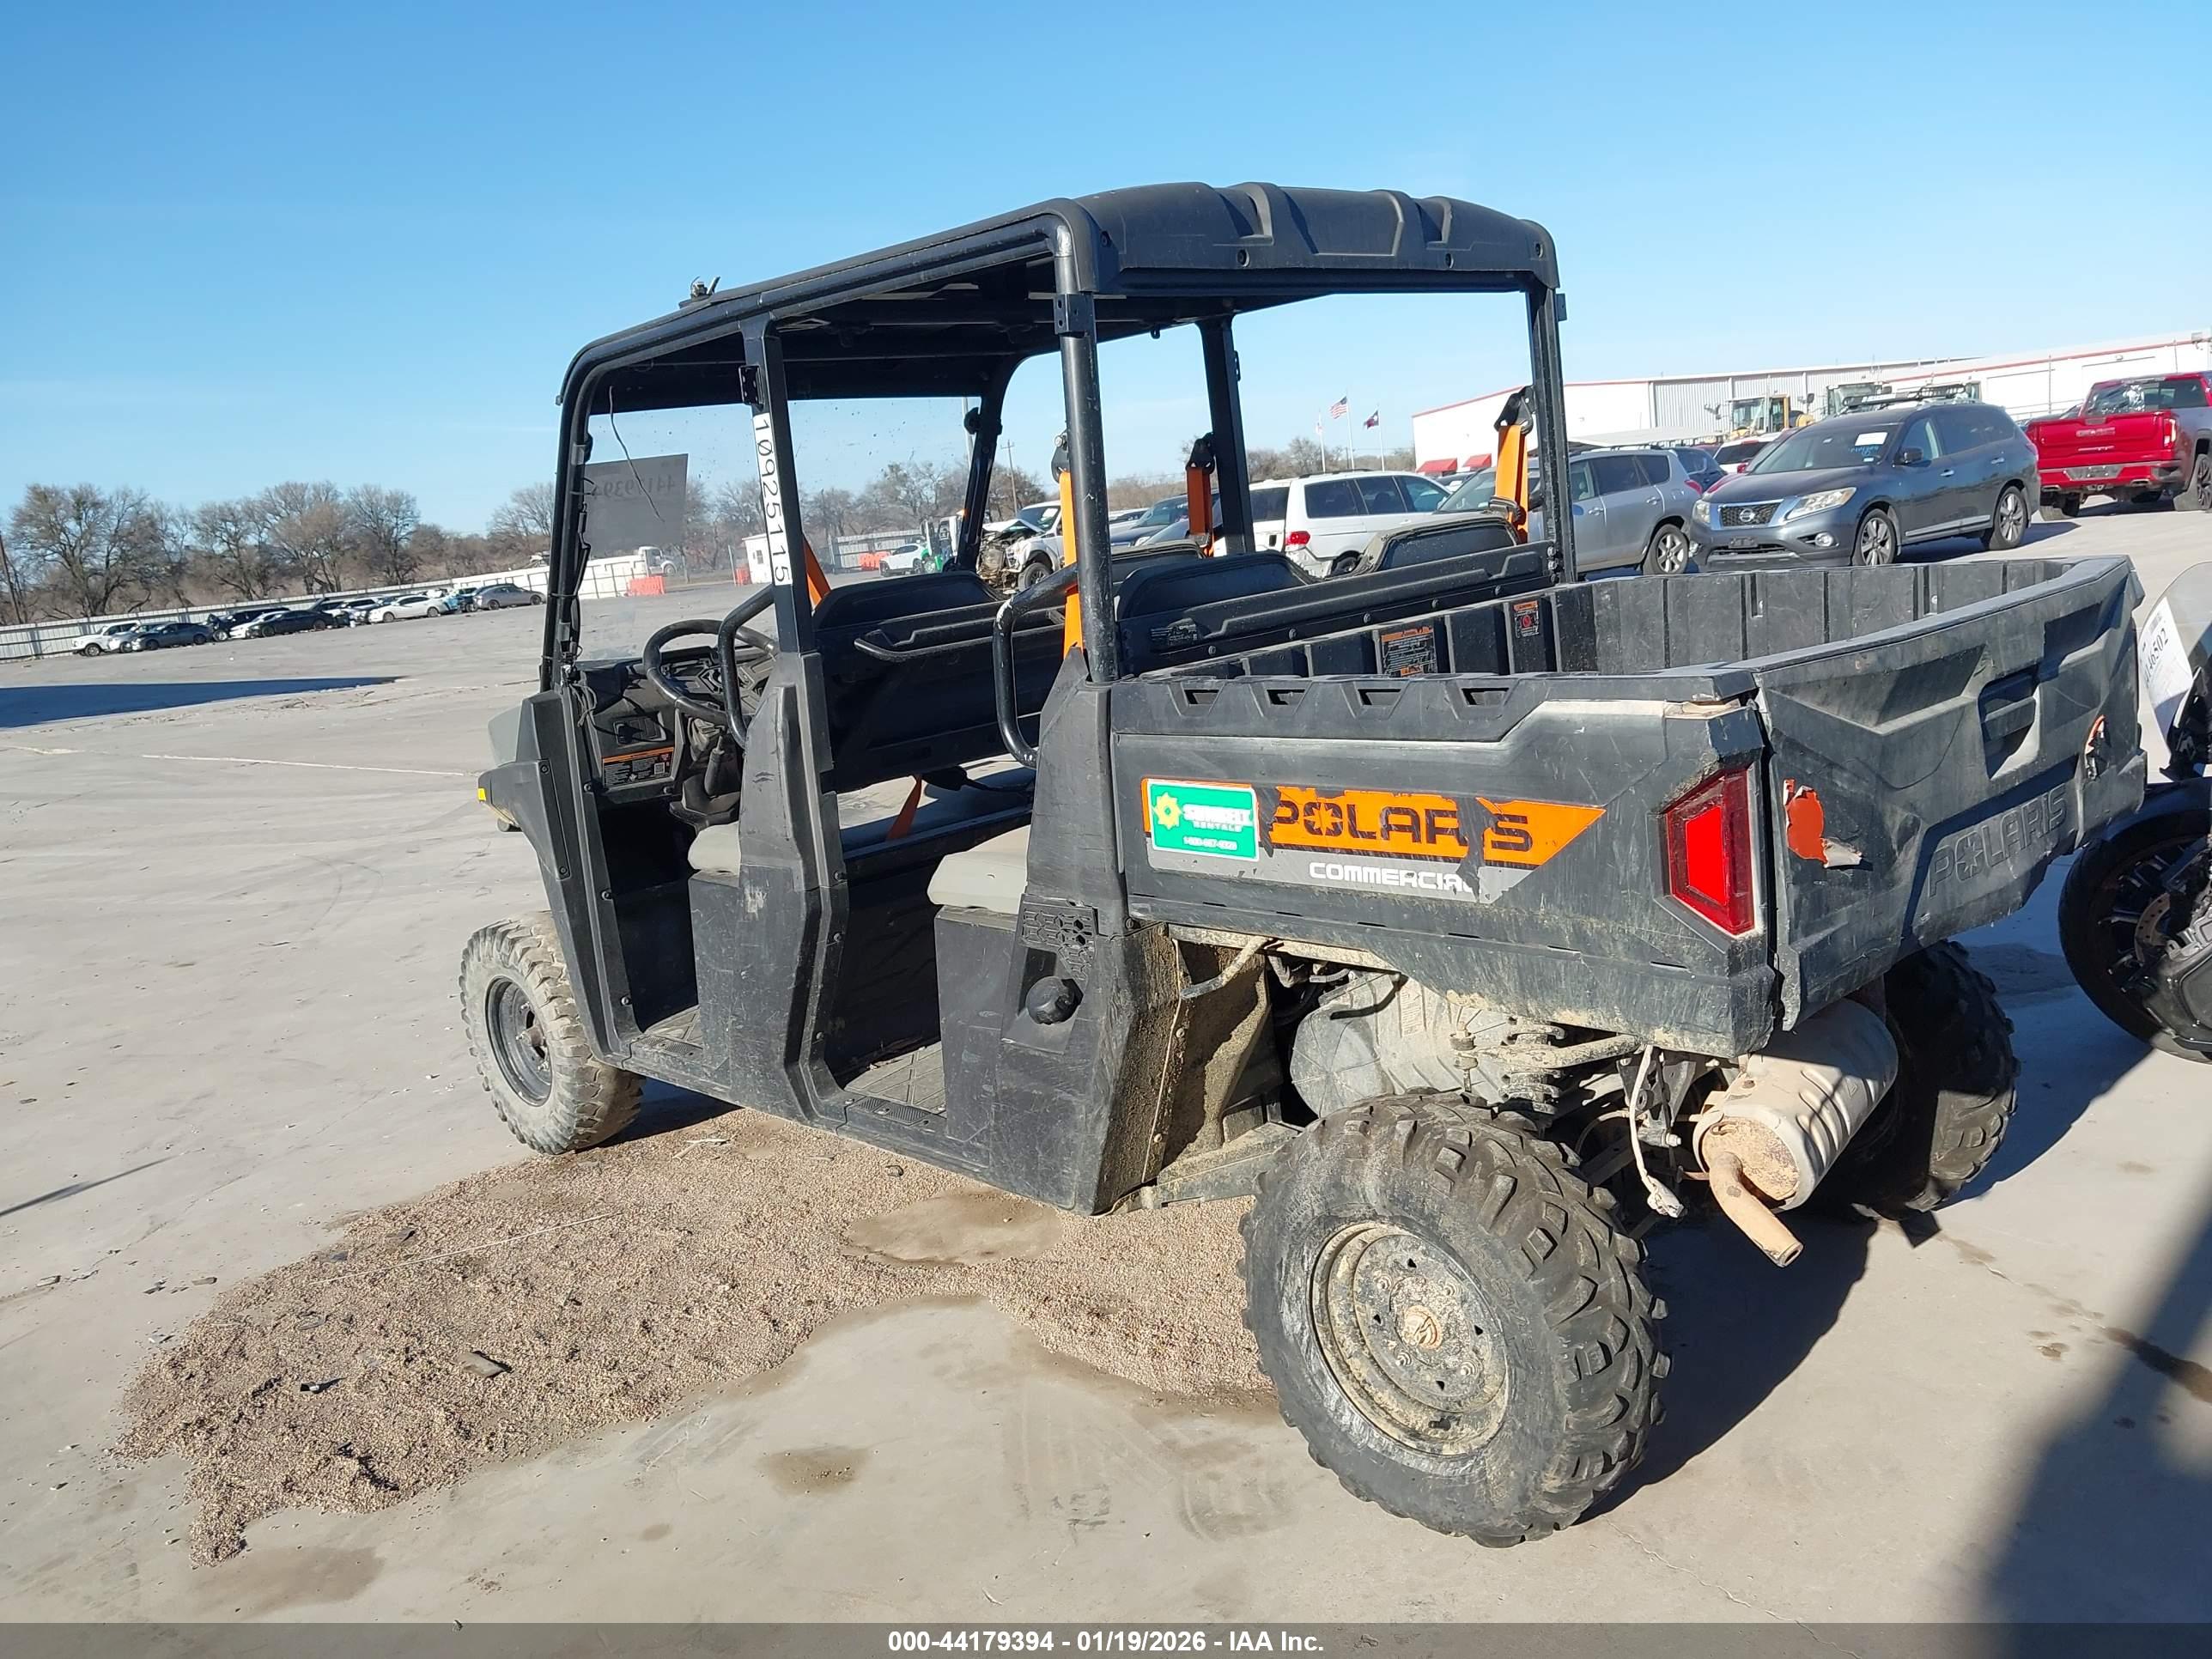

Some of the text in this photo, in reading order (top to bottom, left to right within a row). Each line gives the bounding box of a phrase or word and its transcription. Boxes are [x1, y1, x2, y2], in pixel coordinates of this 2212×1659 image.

[755, 418, 791, 582] 10925115
[1273, 799, 1534, 853] POLARS
[1928, 783, 2068, 898] POLARIS
